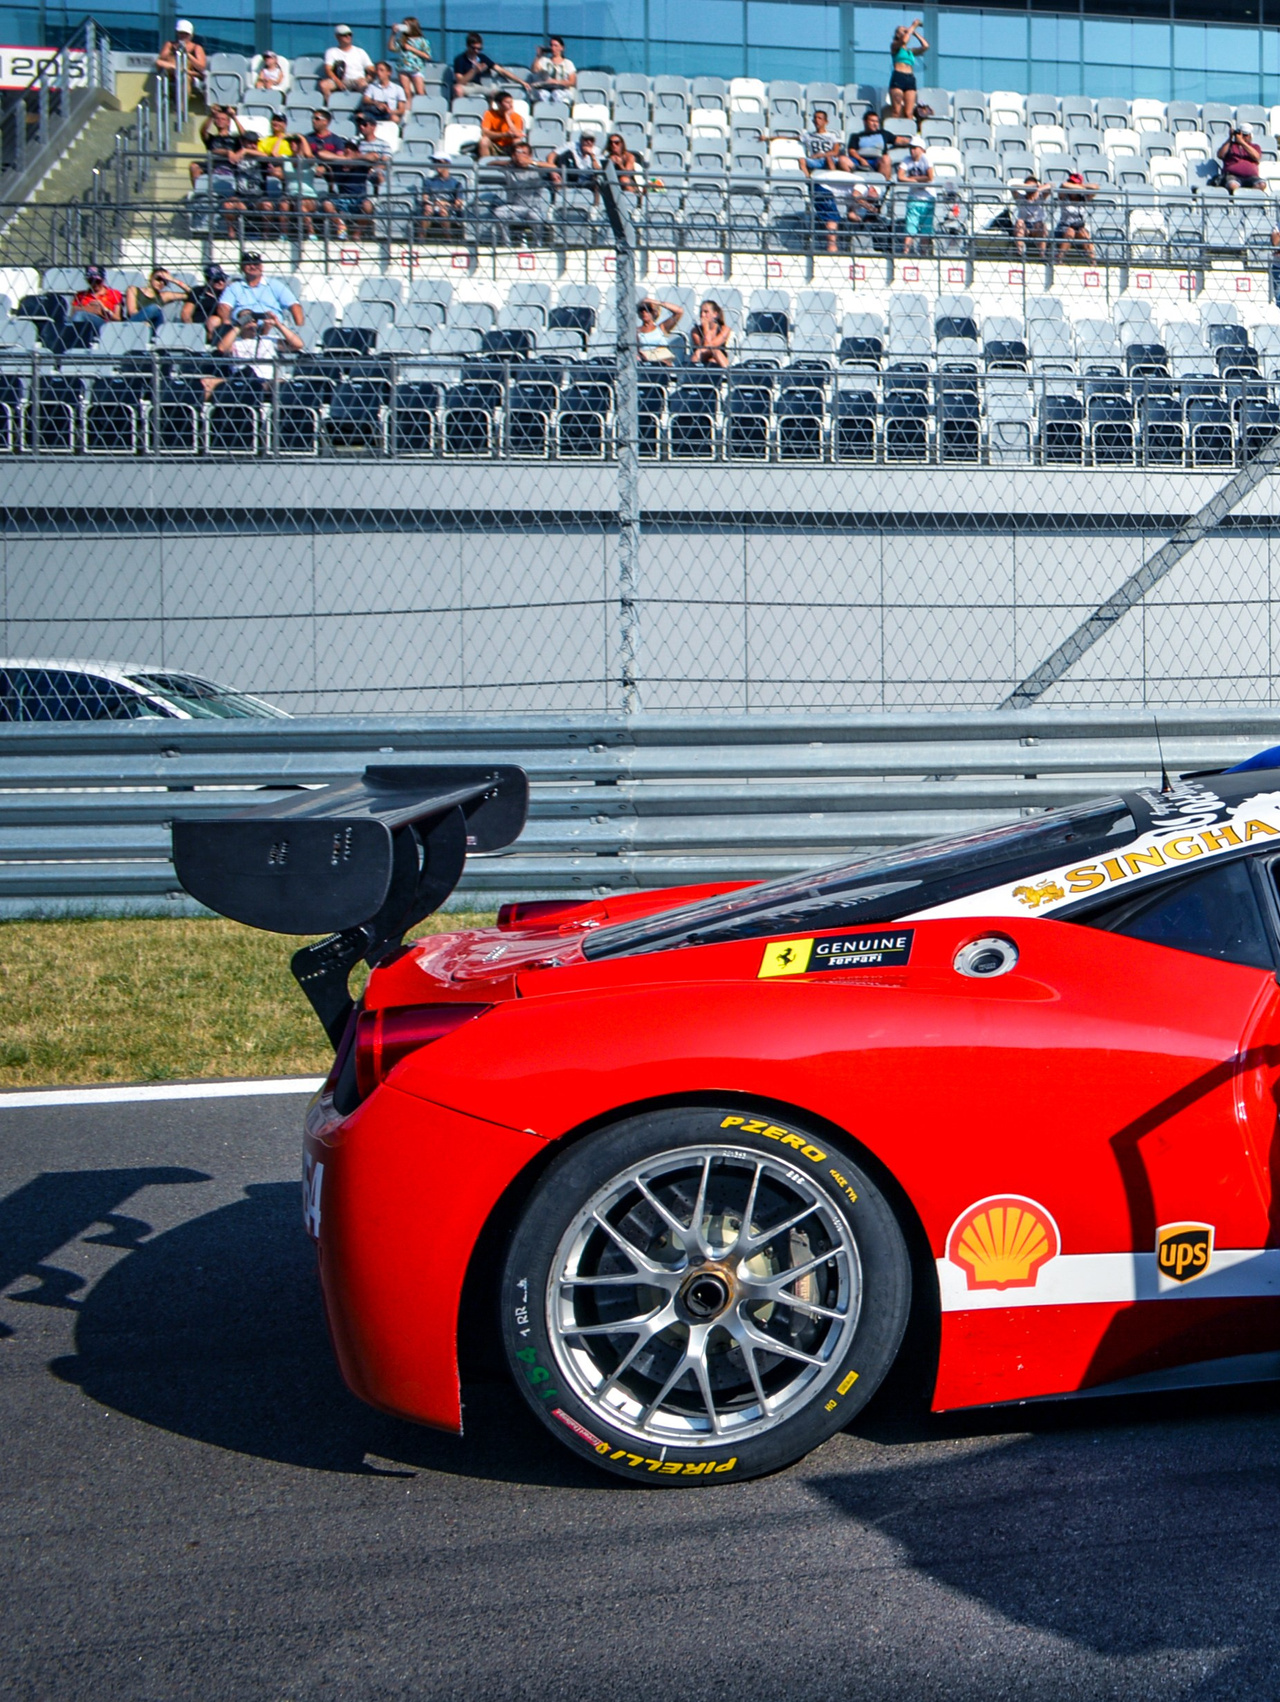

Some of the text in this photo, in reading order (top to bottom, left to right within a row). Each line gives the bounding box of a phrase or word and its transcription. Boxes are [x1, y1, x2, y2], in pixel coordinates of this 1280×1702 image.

[816, 937, 907, 955] GENUINE
[828, 953, 882, 966] Ferrari
[1160, 1240, 1207, 1276] ups
[610, 1450, 737, 1475] PIRELLI
